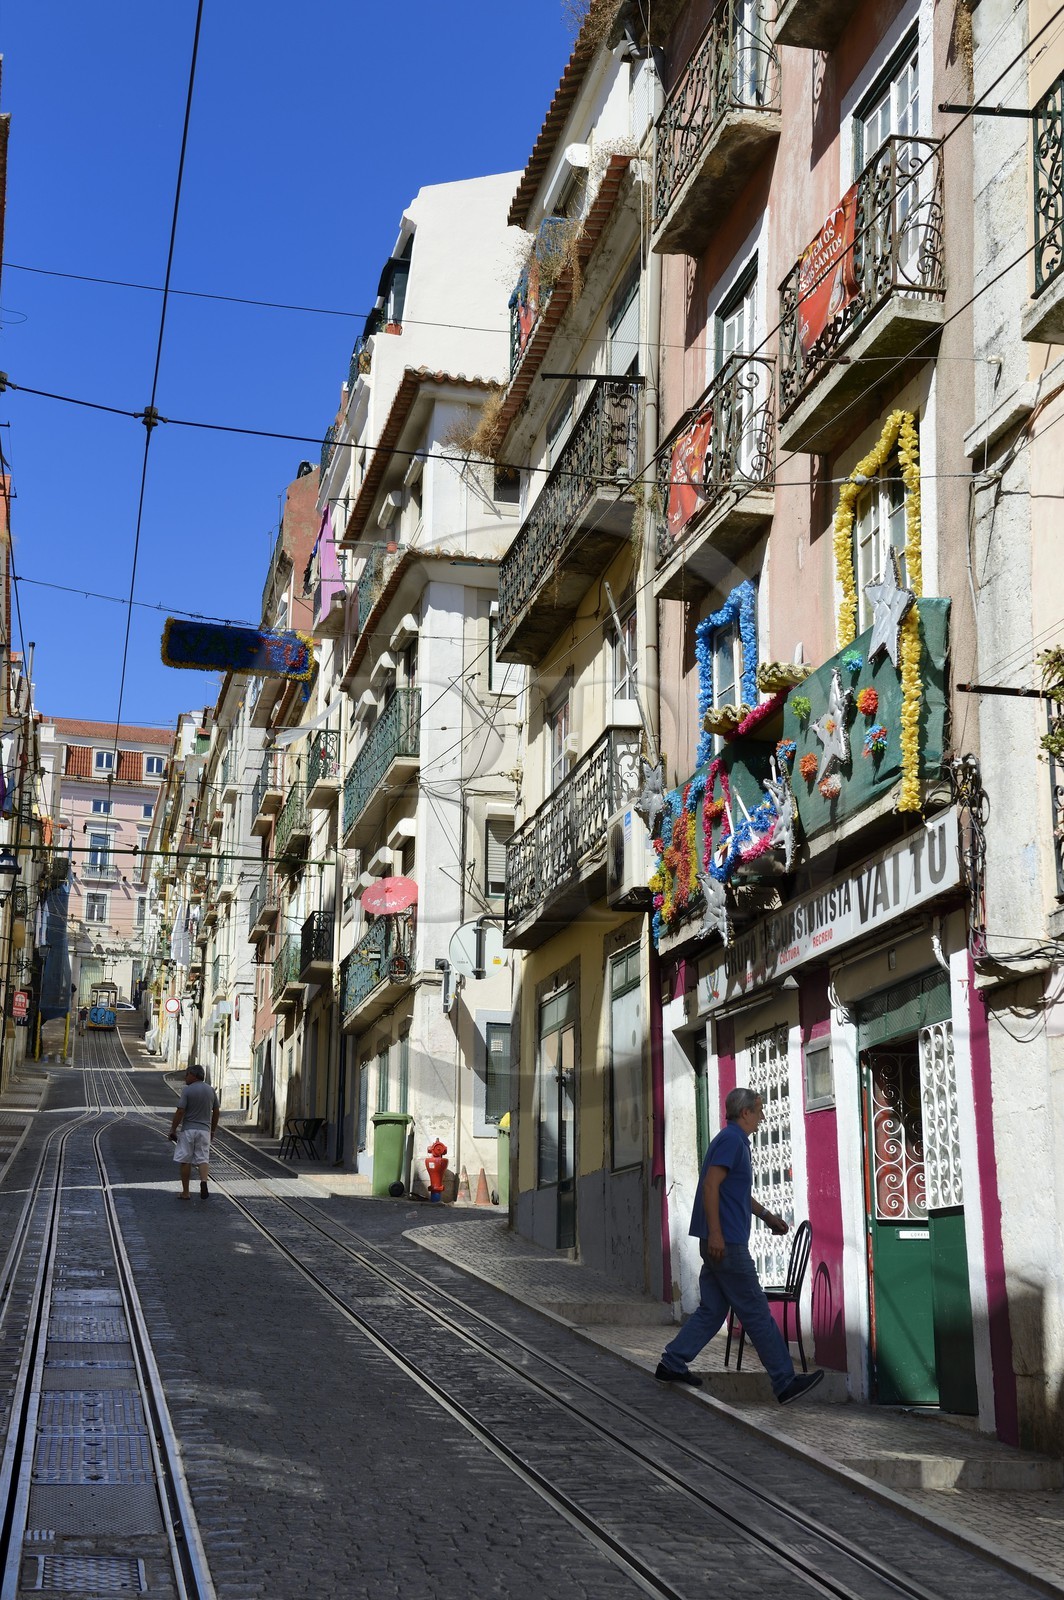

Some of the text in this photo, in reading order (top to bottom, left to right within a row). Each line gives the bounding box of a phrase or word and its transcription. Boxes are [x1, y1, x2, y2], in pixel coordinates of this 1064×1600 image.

[814, 232, 842, 273] SANTOS
[823, 226, 835, 244] OS
[257, 636, 306, 668] TU
[724, 935, 756, 980] GRUPO
[857, 852, 900, 925] VAI
[910, 823, 947, 895] TU
[779, 928, 833, 965] CULTURA RECREIO
